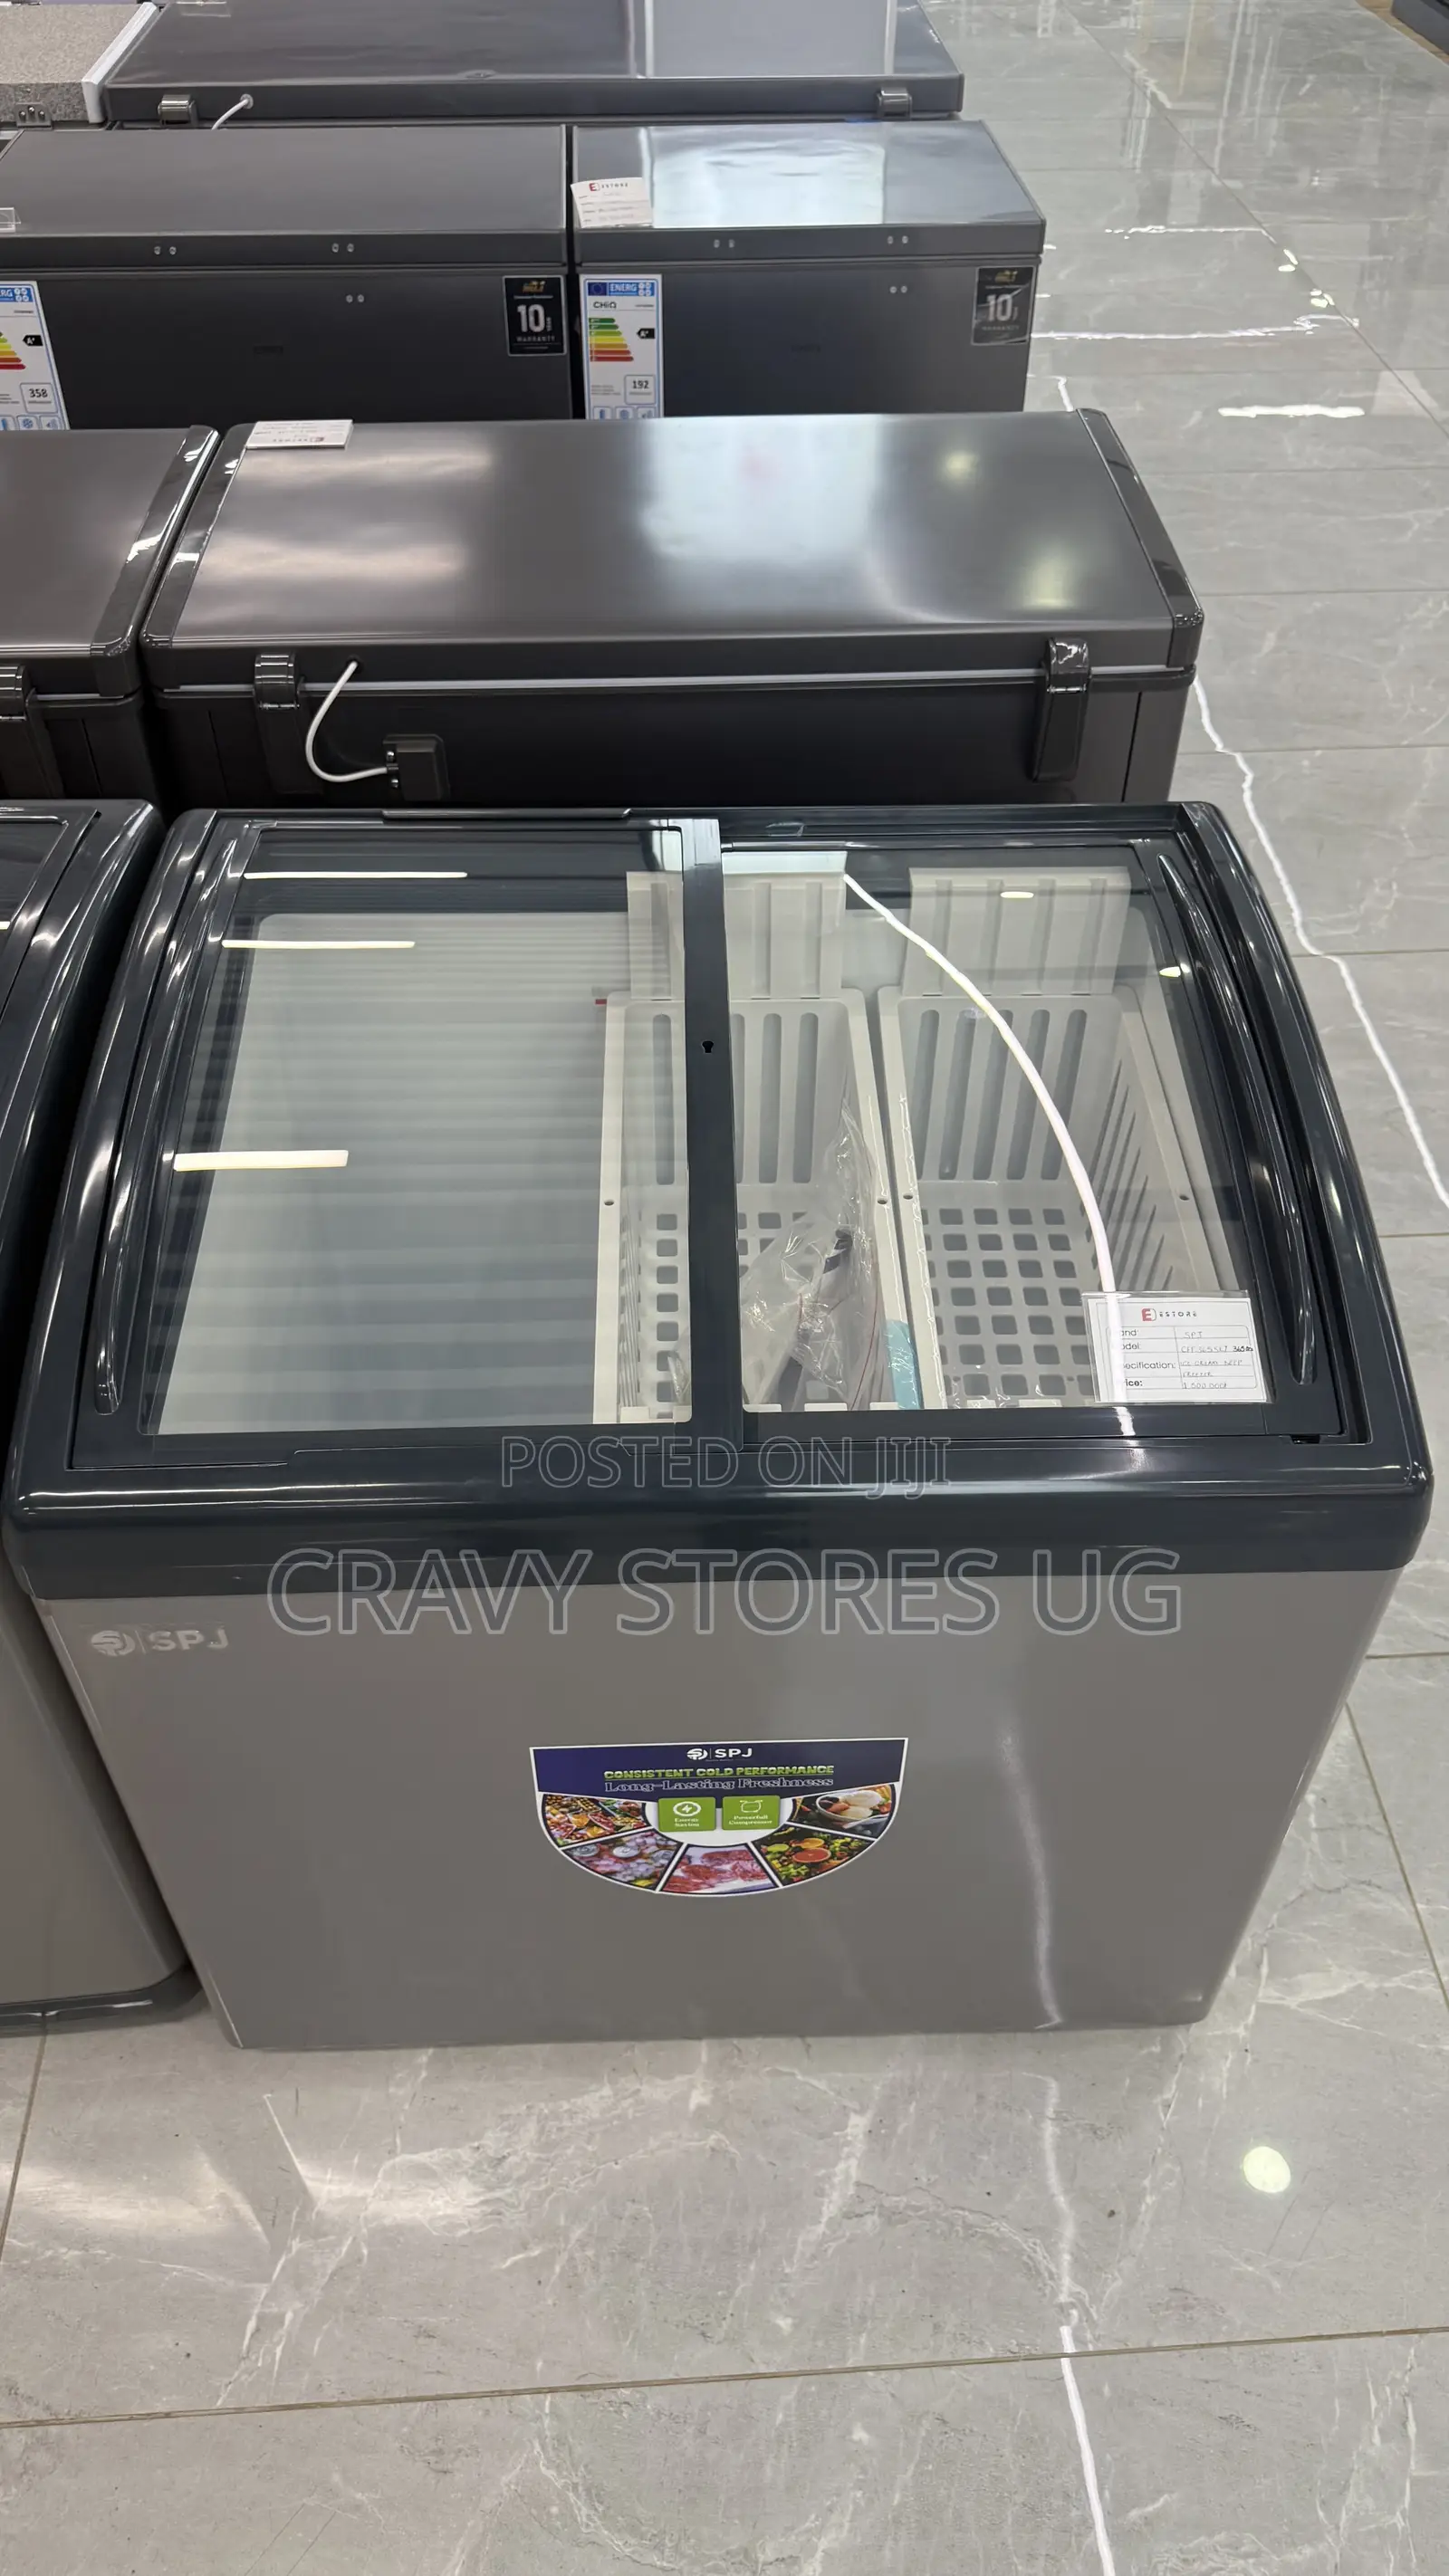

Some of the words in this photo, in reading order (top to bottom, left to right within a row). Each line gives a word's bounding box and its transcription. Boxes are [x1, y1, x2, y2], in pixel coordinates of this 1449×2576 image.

[609, 283, 638, 292] ENERG
[986, 293, 1012, 322] 10
[517, 304, 545, 333] 10
[632, 380, 649, 389] 192
[29, 388, 48, 398] 358
[149, 1628, 228, 1651] SPJ
[715, 1748, 753, 1758] SPJ
[603, 1768, 694, 1779] CONSISTENT
[696, 1767, 734, 1777] COLD
[736, 1765, 834, 1776] PERFORMANCE
[604, 1778, 735, 1792] Long-Lasting
[738, 1776, 833, 1789] Freshness
